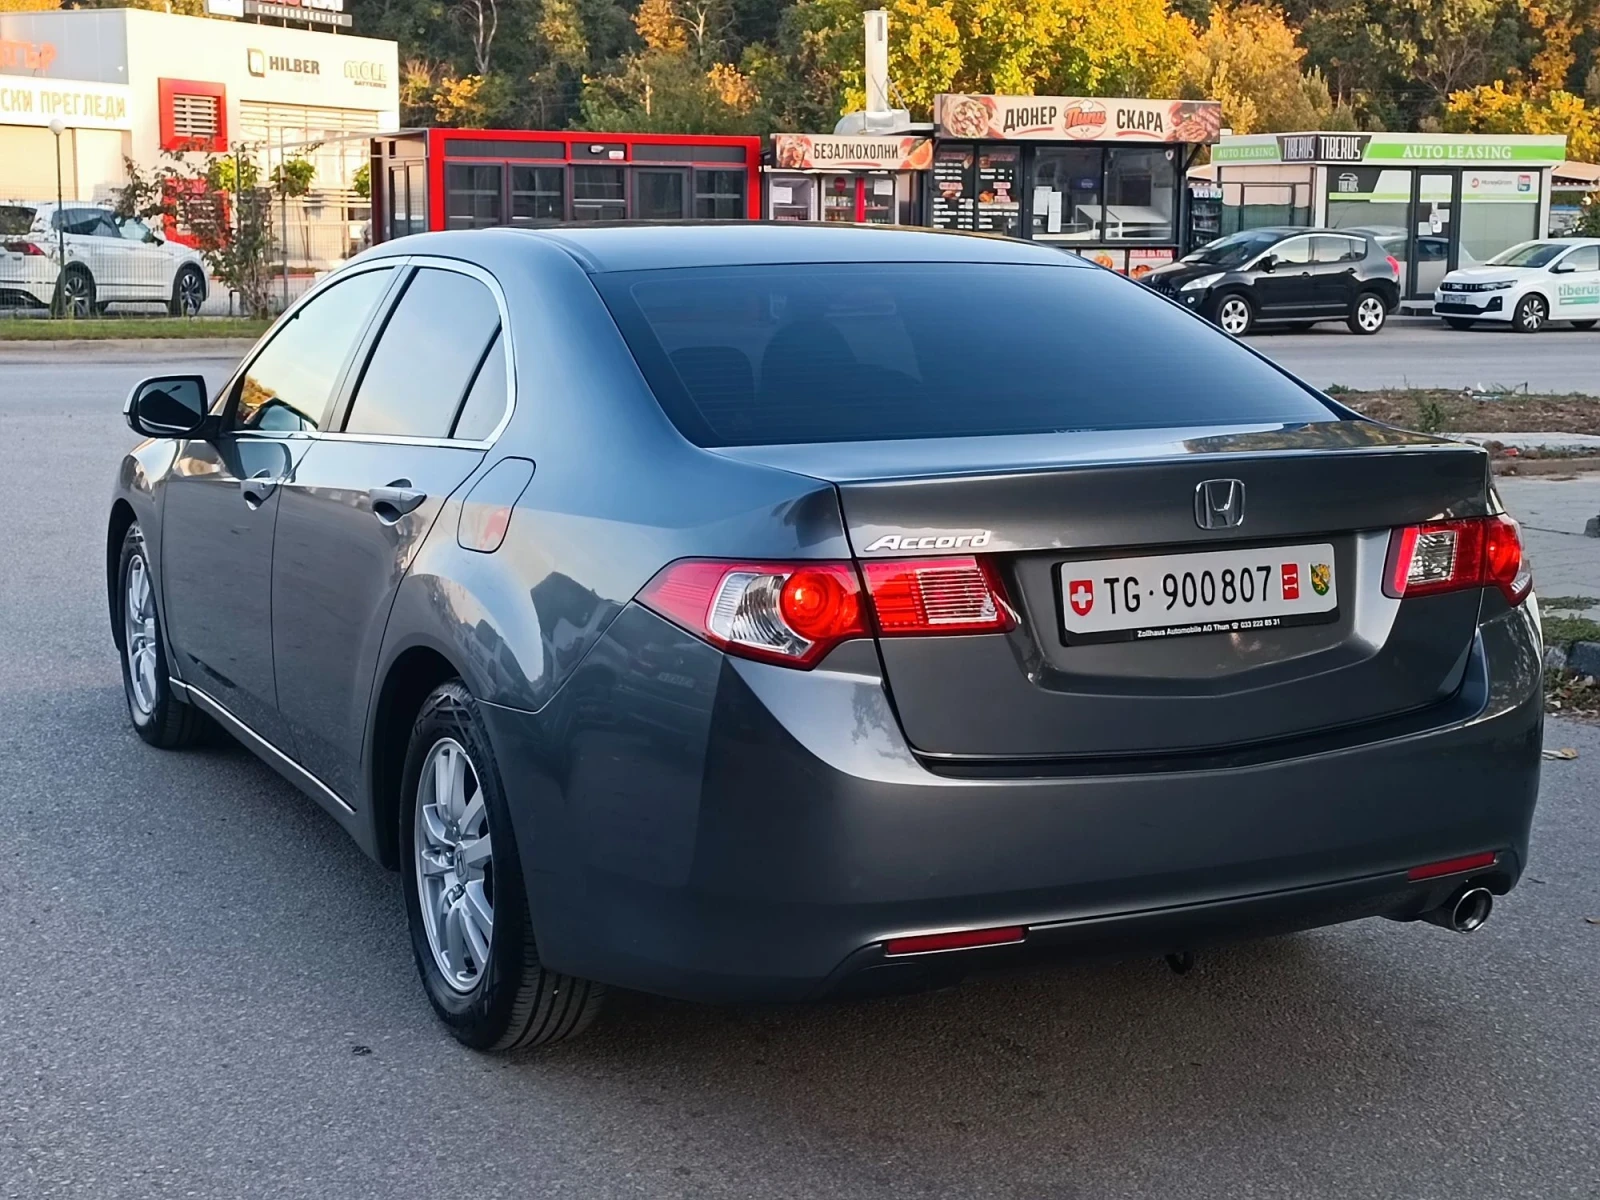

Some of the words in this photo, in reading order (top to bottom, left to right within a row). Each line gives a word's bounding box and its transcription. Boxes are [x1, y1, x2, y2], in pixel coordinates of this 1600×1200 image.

[269, 56, 320, 75] HILBER
[40, 91, 126, 121] ПРЕГЛЕДИ
[1003, 106, 1057, 133] ДЮНЕР
[1116, 108, 1164, 133] СКАРА
[813, 143, 899, 160] БЕЗАЛКОХОЛНИ
[1218, 148, 1239, 158] AUTO
[1240, 147, 1275, 158] LEASING
[1283, 137, 1314, 159] TIBERUS
[1319, 136, 1361, 159] TIBERUS
[1402, 145, 1444, 158] AUTO
[1448, 145, 1512, 159] LEASING
[1558, 284, 1600, 296] tiberus
[865, 531, 991, 553] Accord
[1167, 626, 1202, 635] Automobile
[1203, 624, 1212, 632] AG
[1213, 623, 1230, 631] Thun
